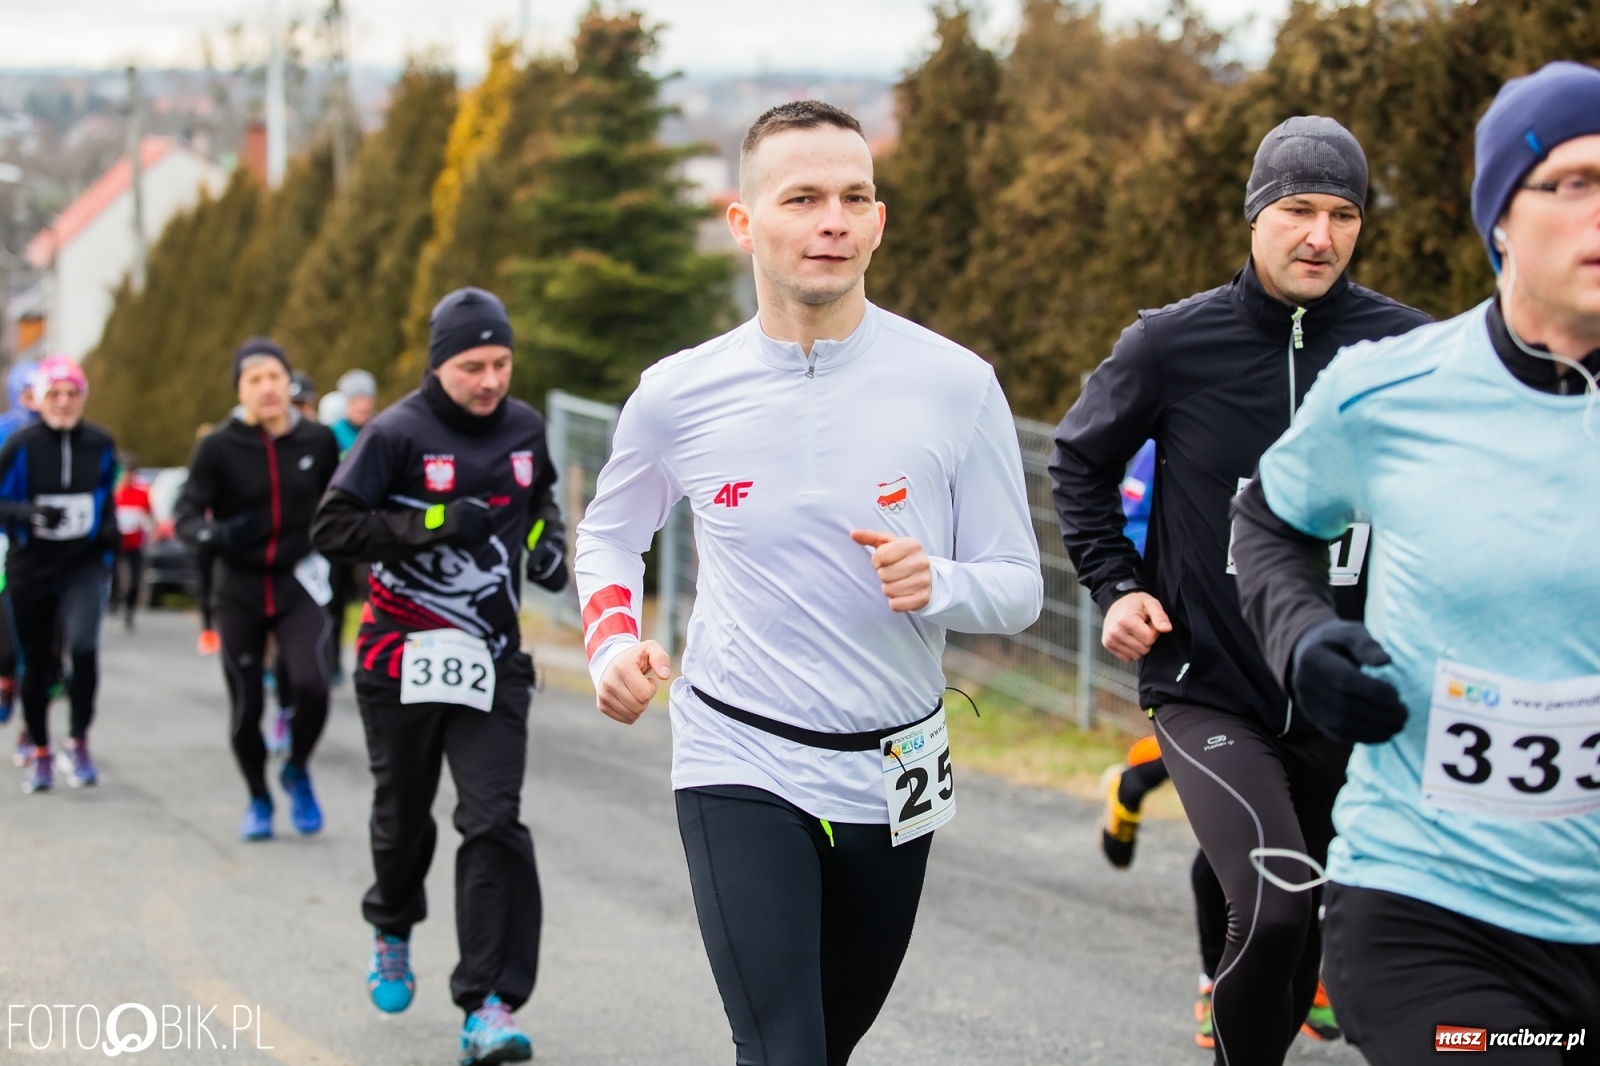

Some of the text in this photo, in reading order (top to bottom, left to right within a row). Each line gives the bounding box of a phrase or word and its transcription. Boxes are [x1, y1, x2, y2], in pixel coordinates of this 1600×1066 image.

[713, 481, 754, 508] 4F
[412, 658, 487, 693] 382
[895, 747, 953, 823] 25
